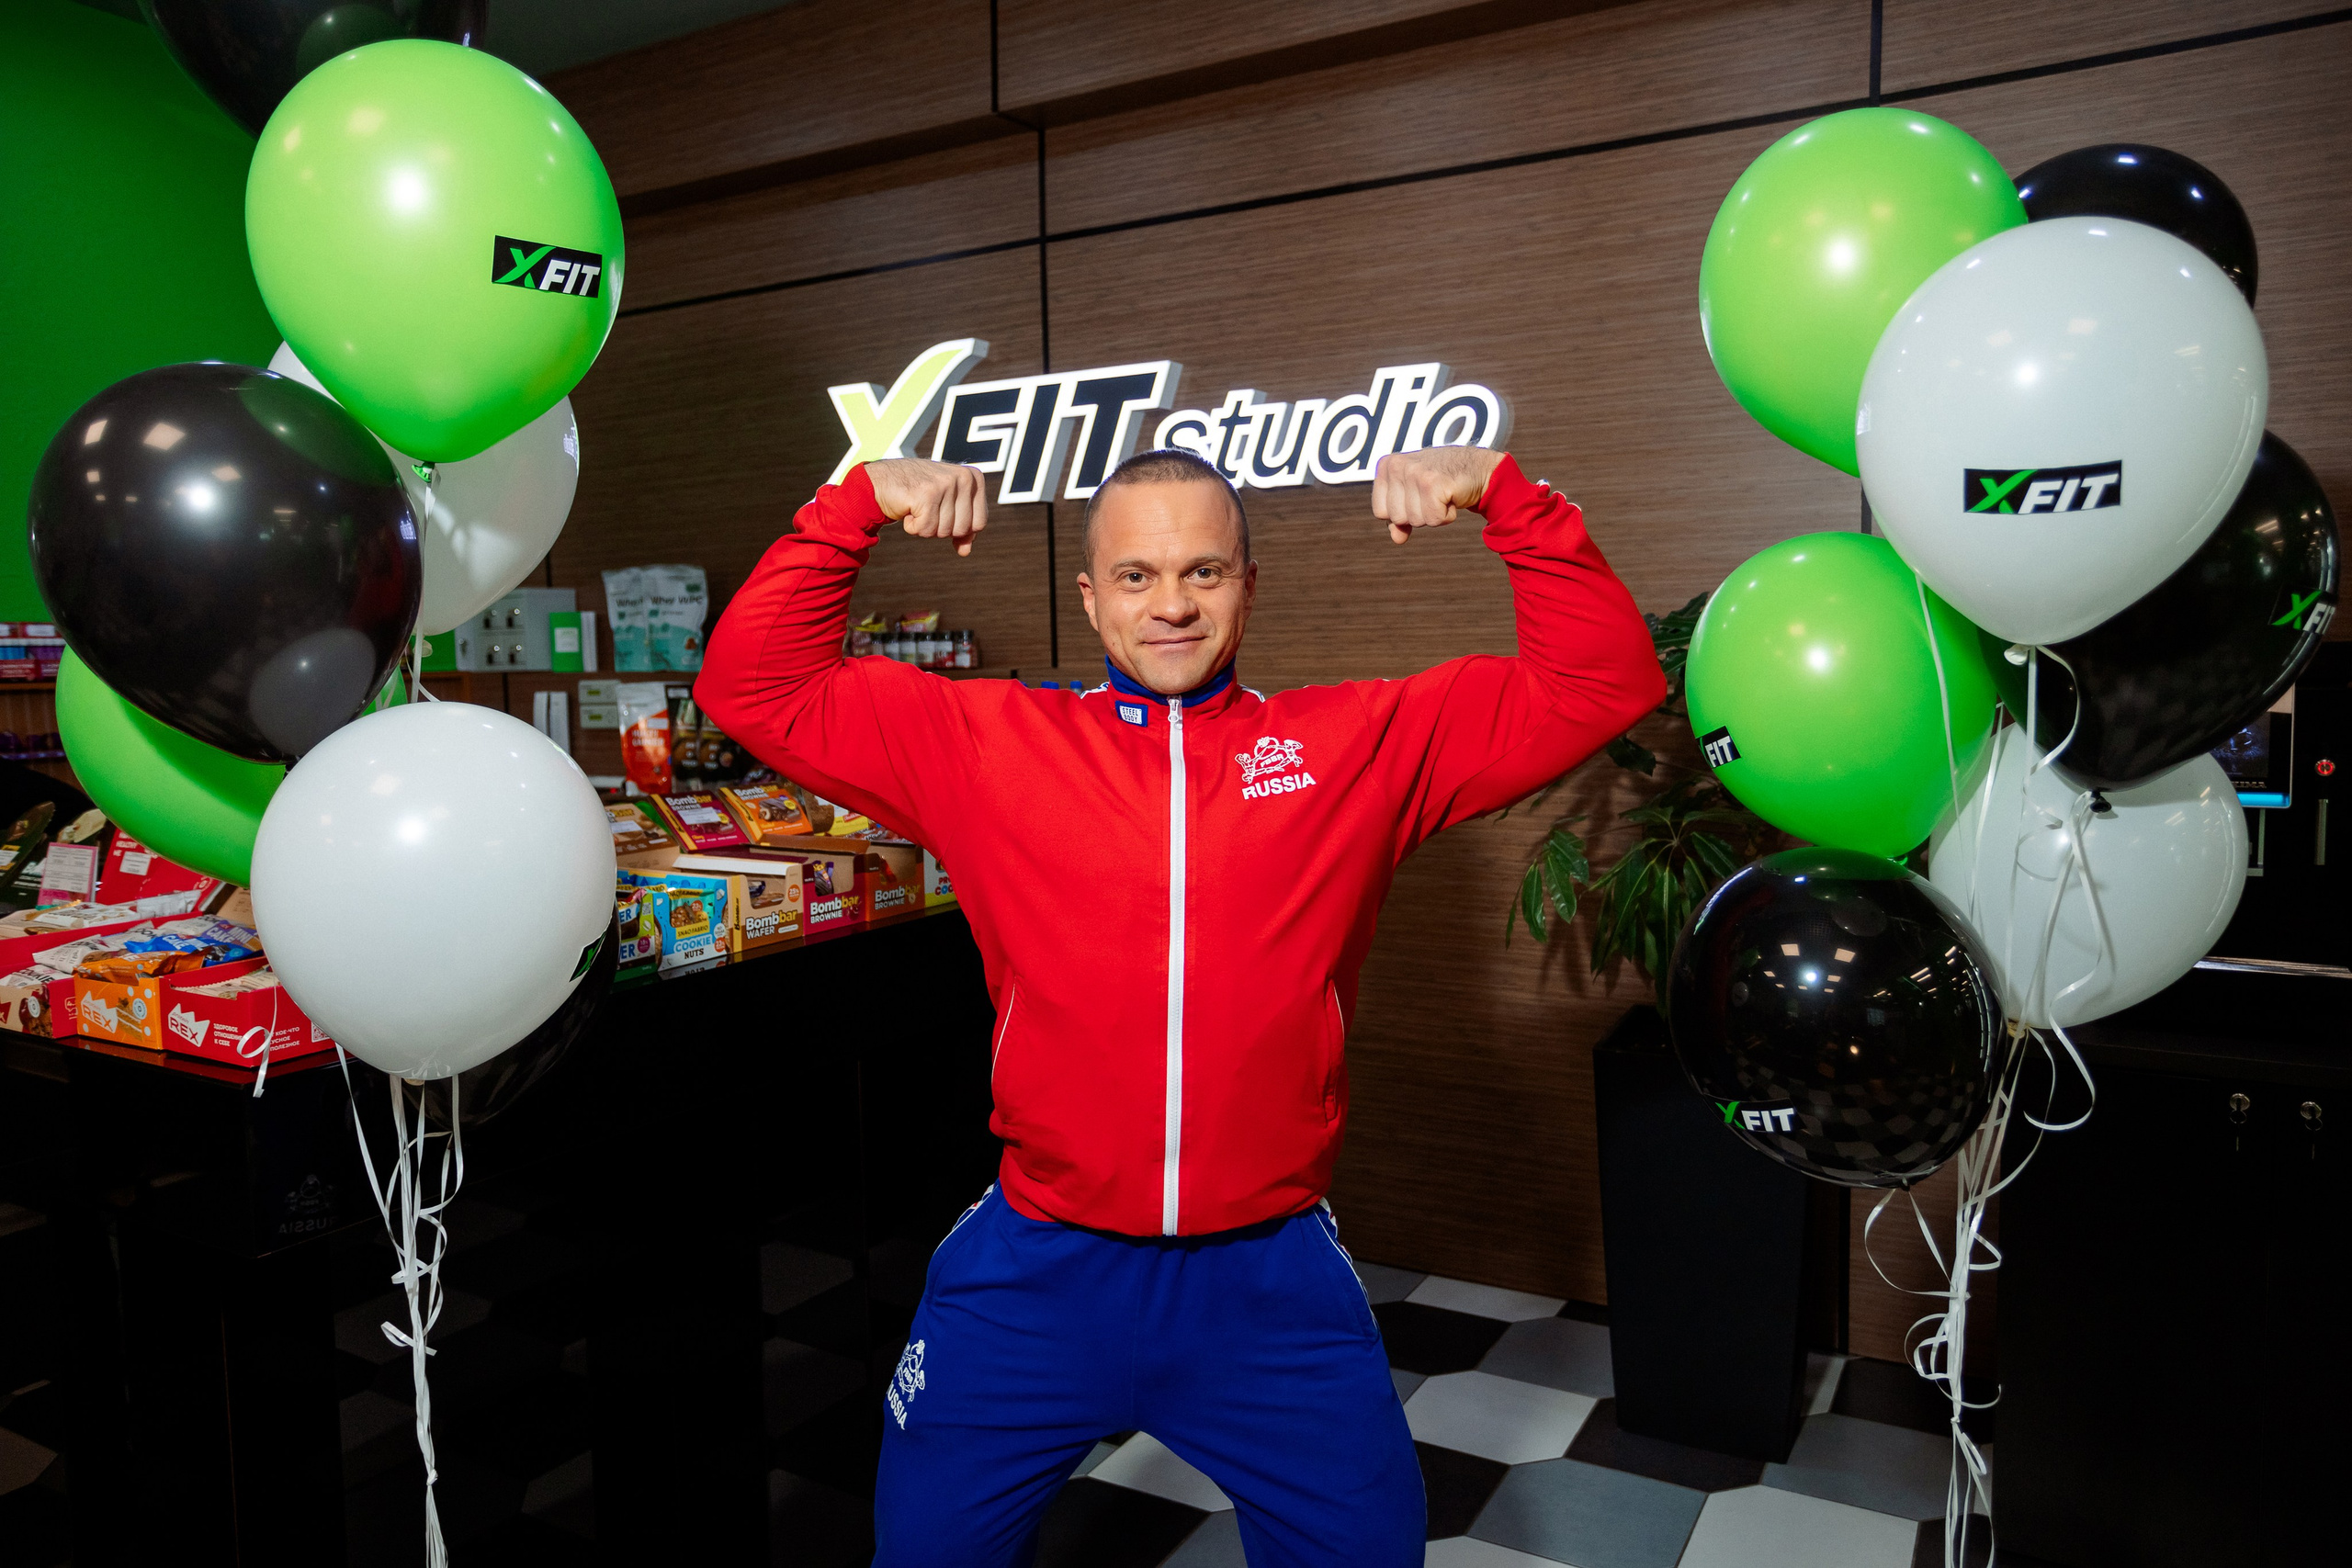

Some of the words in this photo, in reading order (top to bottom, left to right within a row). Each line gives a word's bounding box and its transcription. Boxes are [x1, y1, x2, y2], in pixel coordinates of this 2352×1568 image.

[1966, 468, 2120, 514] XFIT
[1122, 706, 1139, 717] STEEL
[1260, 753, 1284, 768] FBBR
[1700, 736, 1732, 768] FIT
[1242, 772, 1317, 800] RUSSIA
[874, 885, 921, 902] Bombbar
[809, 896, 860, 915] Bombbar
[875, 897, 905, 910] BROWNIE
[745, 908, 797, 931] Bombbar
[810, 909, 842, 924] BROWNIE
[746, 925, 775, 940] WAFER
[674, 936, 711, 952] COOKIE
[684, 948, 705, 960] NUTS
[83, 1004, 114, 1032] REX
[169, 1016, 199, 1045] REX
[886, 1380, 907, 1430] USSIA
